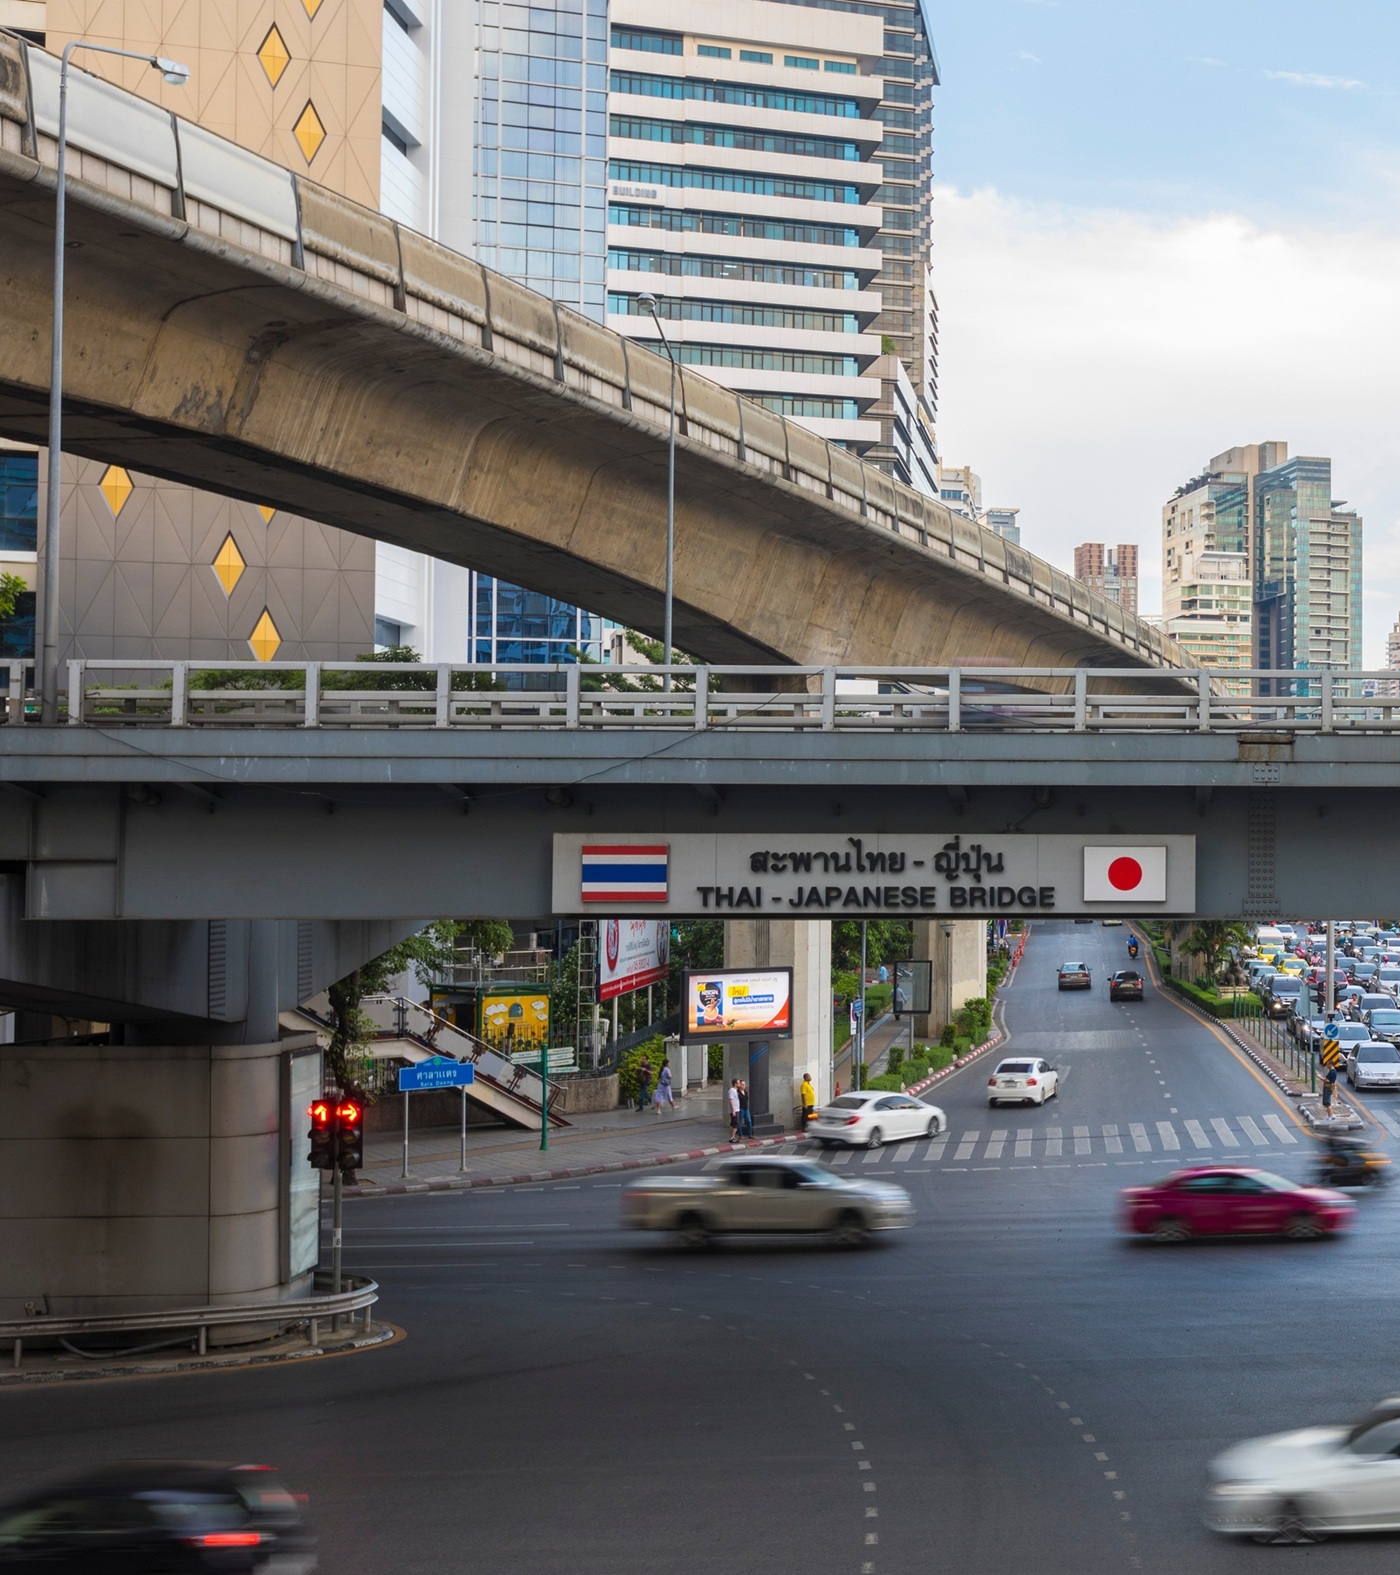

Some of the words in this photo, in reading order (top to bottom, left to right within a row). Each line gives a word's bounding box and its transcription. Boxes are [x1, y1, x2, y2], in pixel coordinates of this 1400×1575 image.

[612, 185, 657, 199] BUILDING
[750, 837, 905, 873] สะพานไทย
[934, 835, 1004, 883] ญี่ปุ่น
[697, 886, 761, 907] THAI
[789, 886, 936, 907] JAPANESE
[950, 886, 1055, 907] BRIDGE
[416, 1069, 458, 1080] ศาลาแดง
